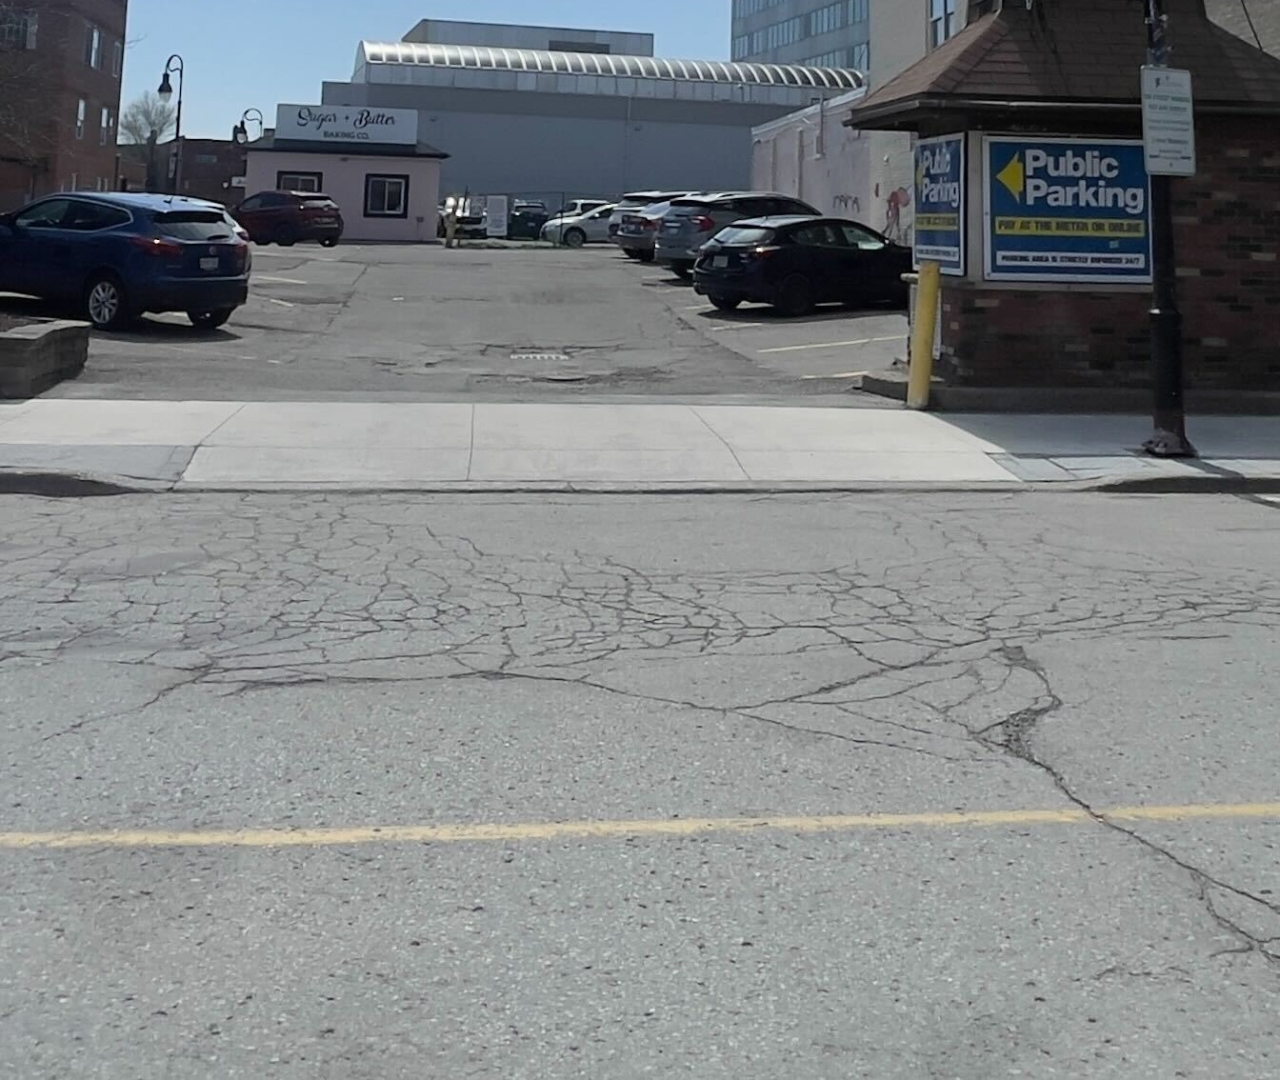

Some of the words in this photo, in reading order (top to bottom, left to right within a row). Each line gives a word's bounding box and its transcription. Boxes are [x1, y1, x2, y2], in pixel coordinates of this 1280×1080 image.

[297, 107, 337, 130] Sugar
[353, 109, 395, 129] Butter
[323, 131, 355, 139] BAKING
[923, 143, 951, 175] Public
[1025, 149, 1118, 178] Public
[922, 177, 960, 208] Parking
[1026, 178, 1144, 214] Parking
[1035, 220, 1052, 231] THE
